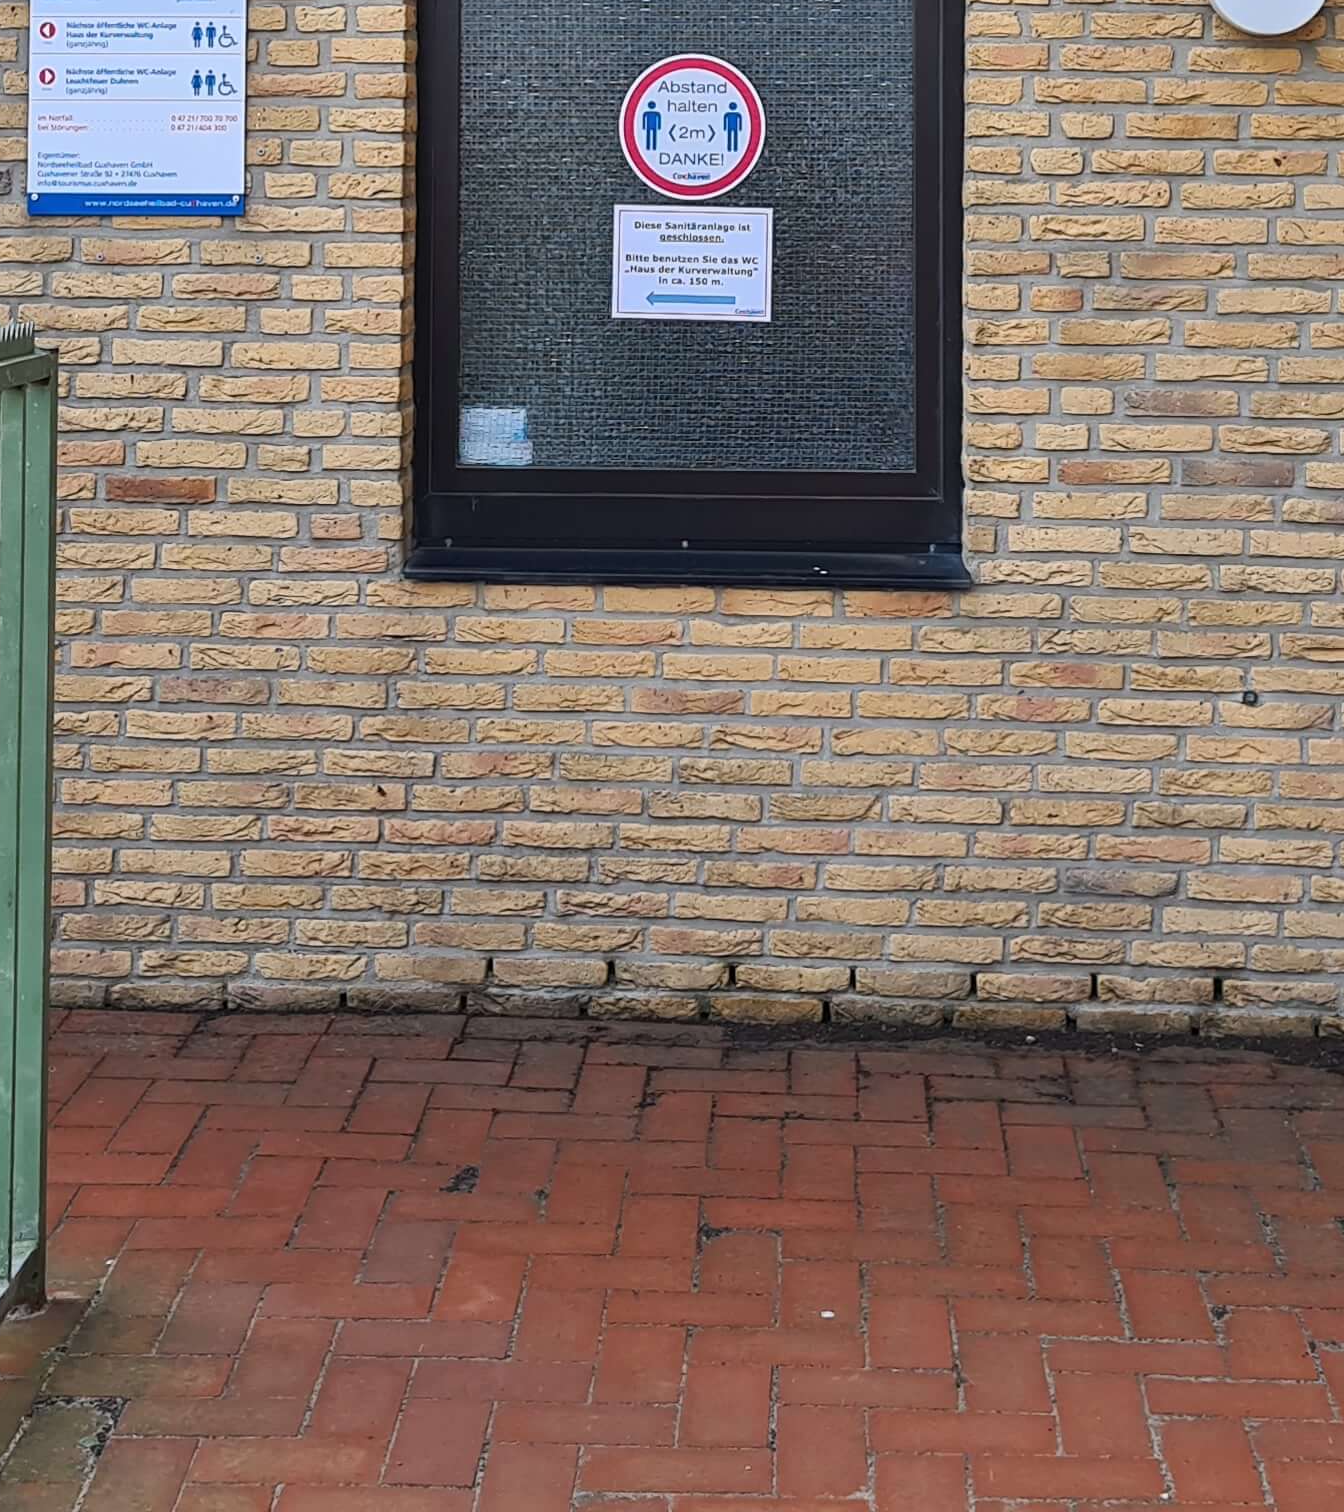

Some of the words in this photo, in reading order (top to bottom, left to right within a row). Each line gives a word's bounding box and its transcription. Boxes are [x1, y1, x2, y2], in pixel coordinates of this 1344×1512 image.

[658, 80, 728, 94] Abstand
[667, 99, 718, 112] halten
[659, 152, 724, 166] DANKE!
[634, 221, 662, 229] Diese
[665, 221, 735, 232] Sanitäranlage
[738, 223, 751, 231] ist
[659, 232, 725, 243] geschlossen.
[625, 254, 650, 262] Bitte
[652, 254, 700, 263] benutzen
[702, 255, 718, 263] Sie
[721, 256, 738, 264] das
[742, 257, 759, 265] WC
[658, 265, 676, 274] der
[689, 277, 708, 285] 150
